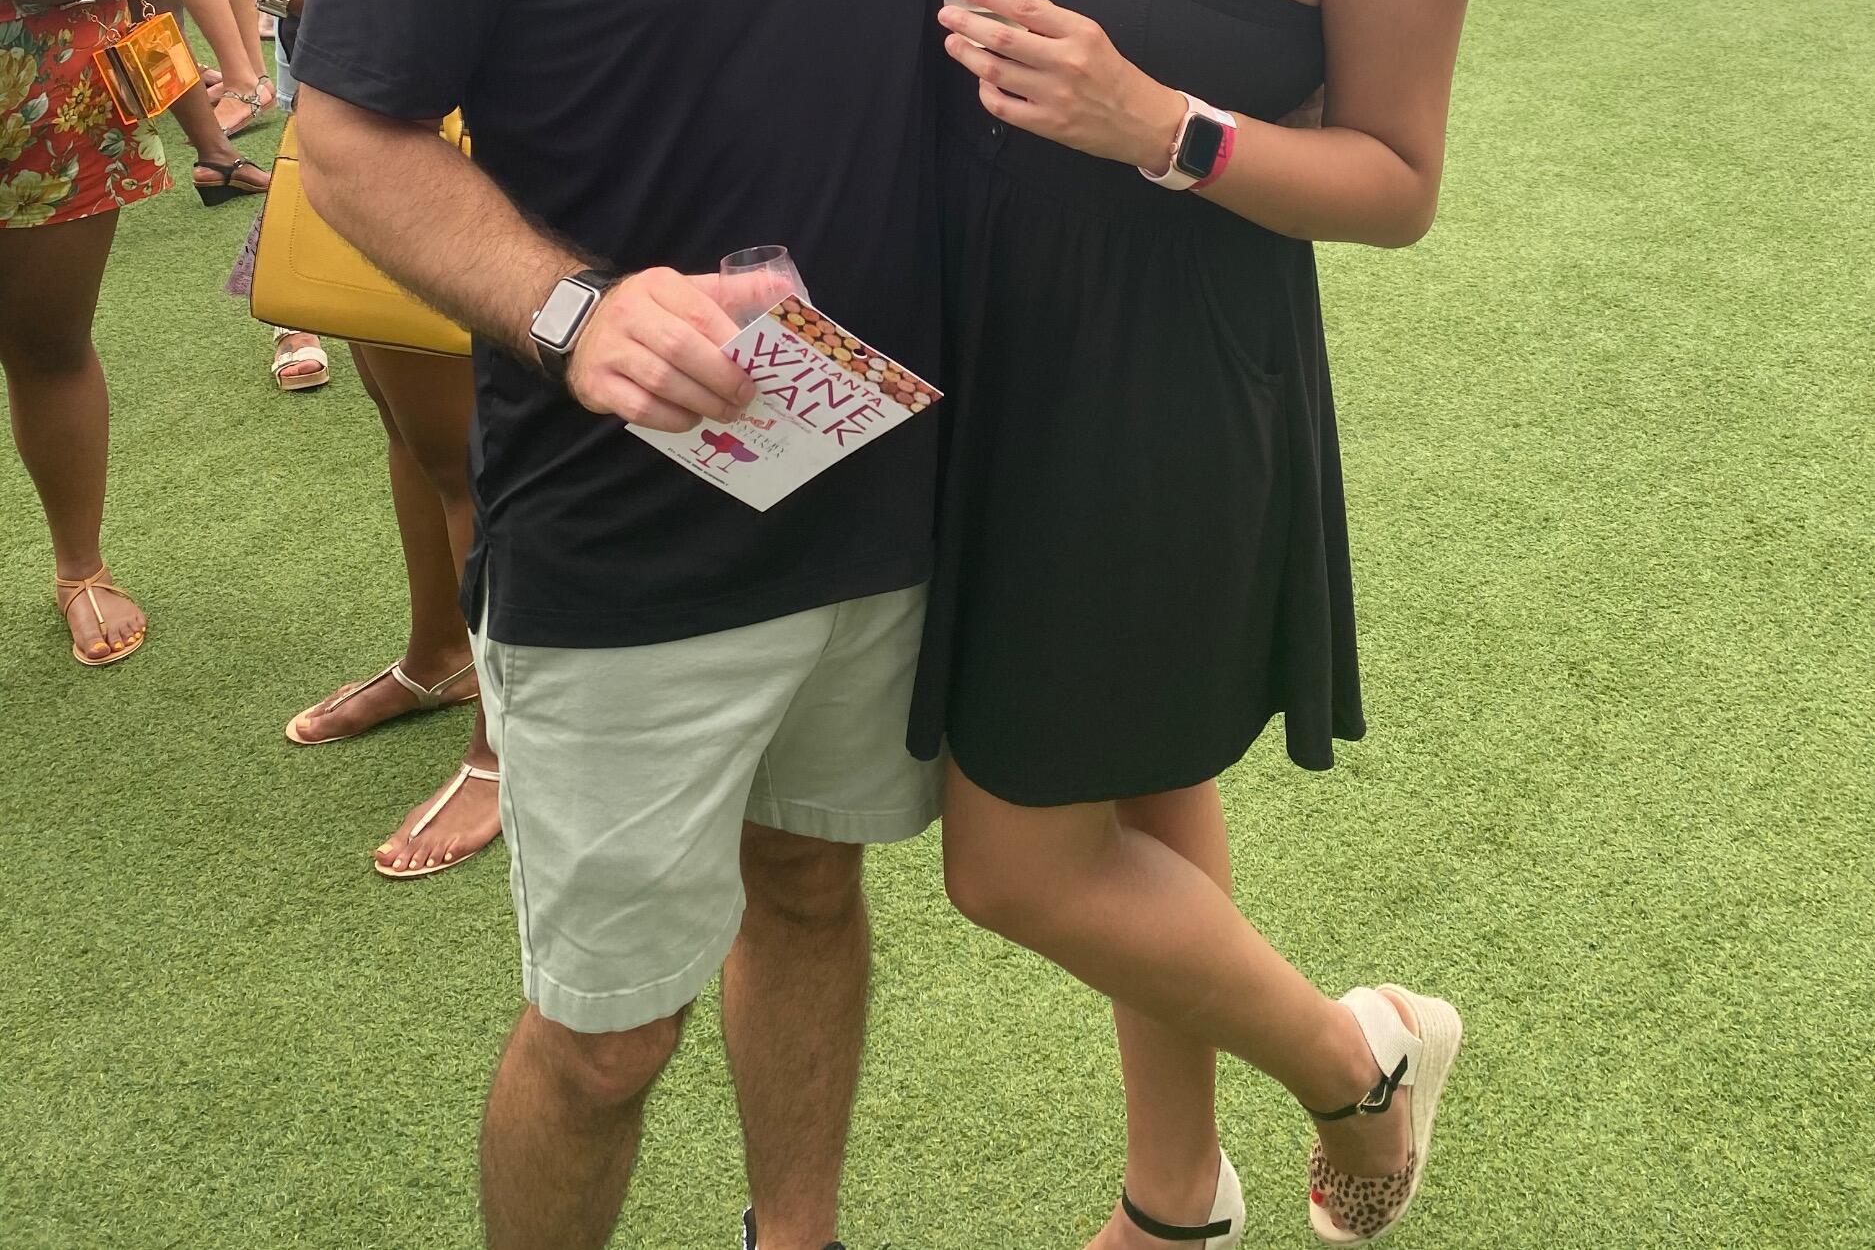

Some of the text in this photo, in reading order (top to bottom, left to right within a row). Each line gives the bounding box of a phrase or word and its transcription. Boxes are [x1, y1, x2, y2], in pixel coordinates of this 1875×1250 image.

[731, 348, 864, 447] WALK
[753, 331, 885, 432] WINE
[795, 347, 882, 408] ATLANTA
